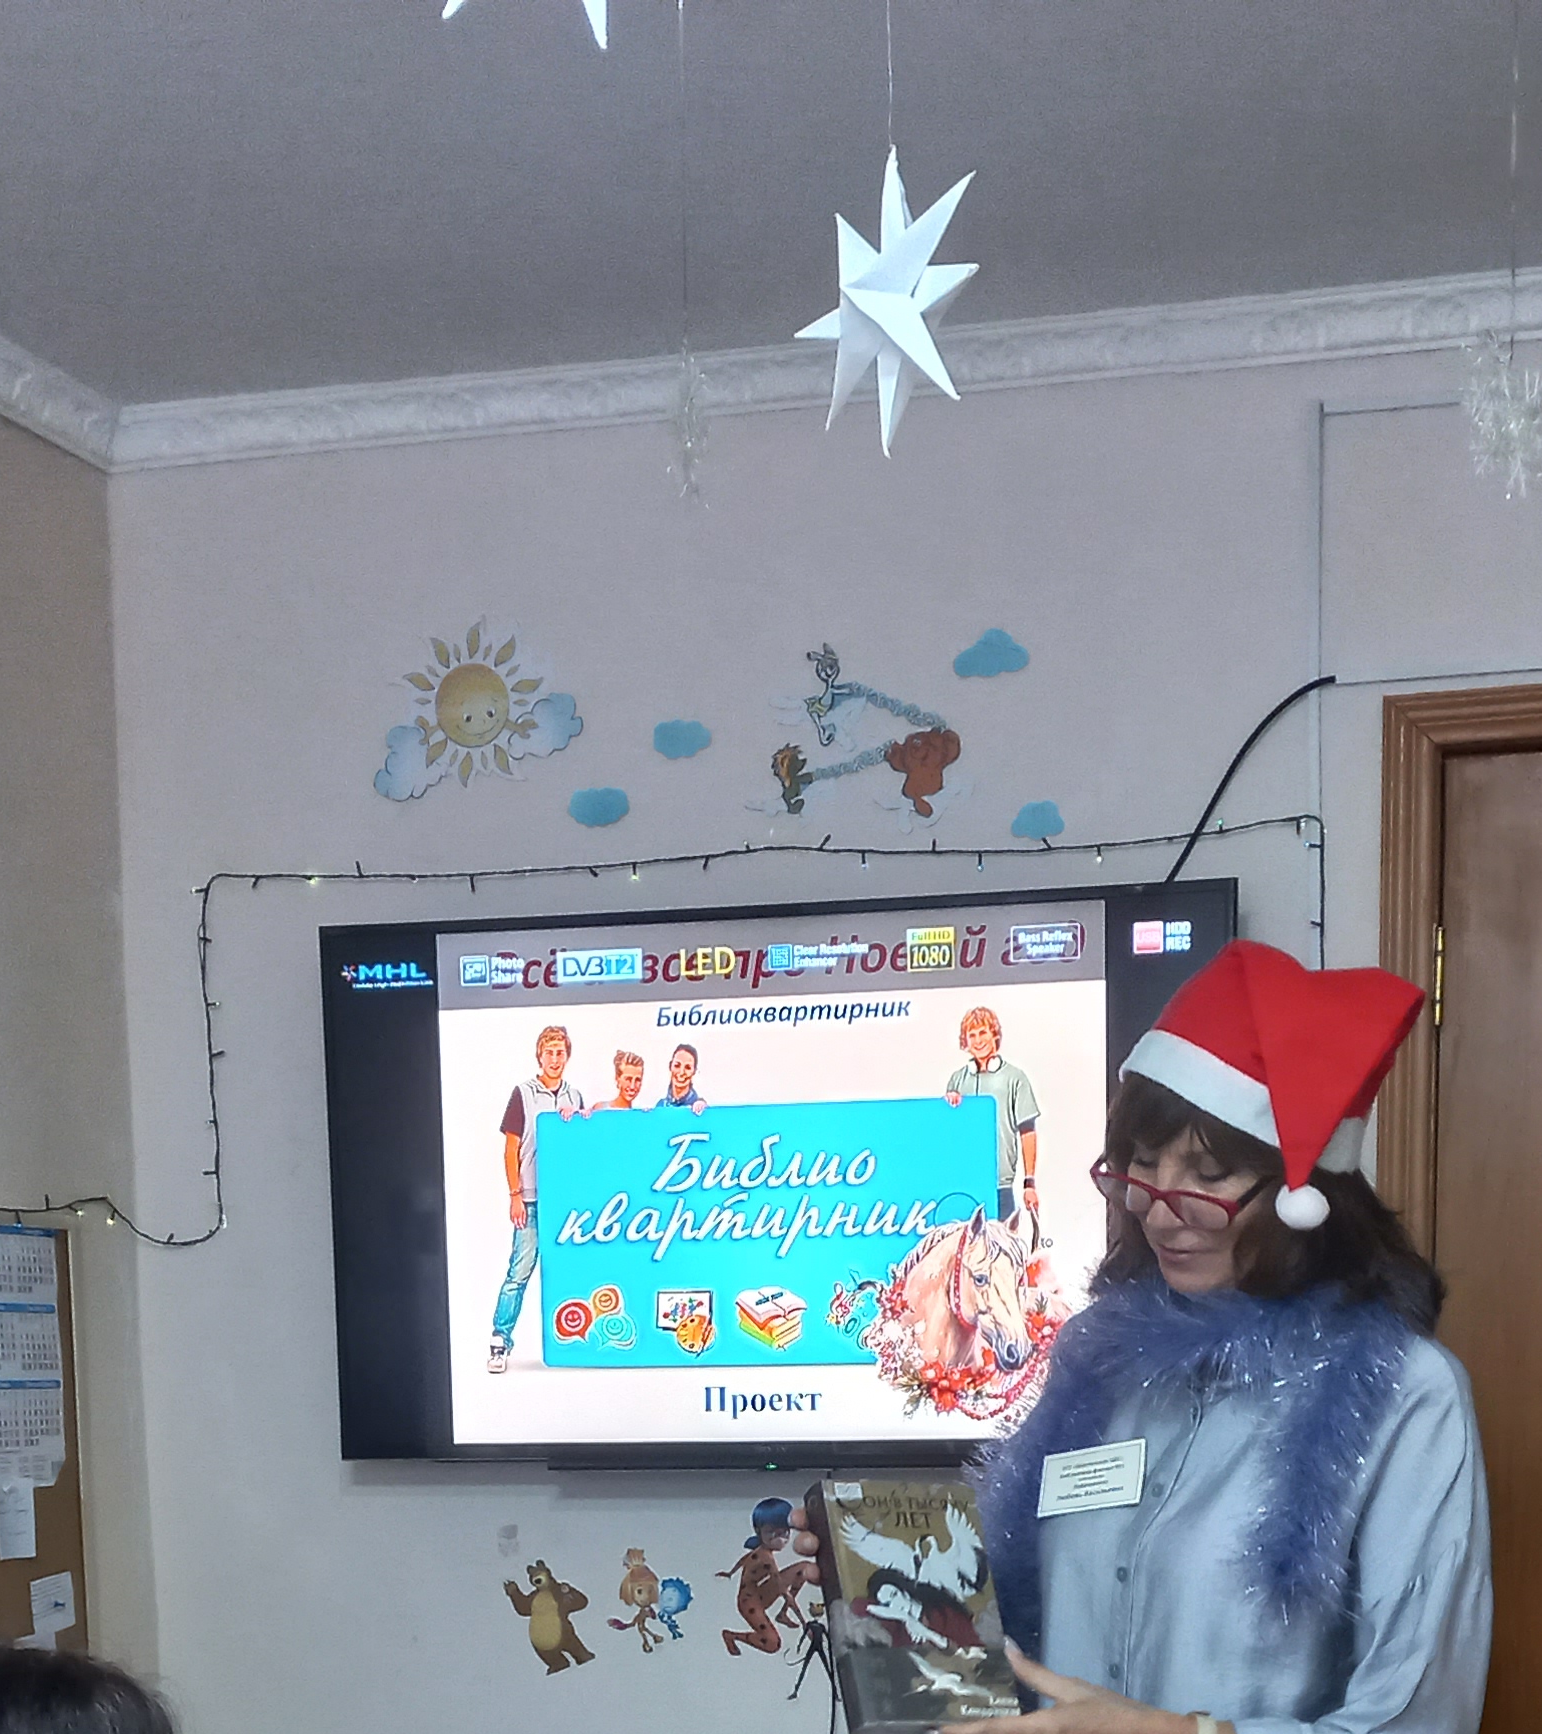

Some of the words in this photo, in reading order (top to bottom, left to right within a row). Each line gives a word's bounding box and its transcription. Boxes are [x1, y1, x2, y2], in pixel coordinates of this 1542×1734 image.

[932, 930, 951, 940] HD
[491, 956, 524, 971] Photo
[679, 946, 736, 976] LED
[911, 945, 951, 967] 1080
[358, 962, 428, 981] MHL
[491, 970, 523, 985] Share
[656, 1000, 911, 1028] Библиоквартирник
[652, 1131, 878, 1194] Библио
[556, 1191, 939, 1262] квартирник
[704, 1385, 822, 1420] Проект
[894, 1511, 932, 1529] ЛЕТ
